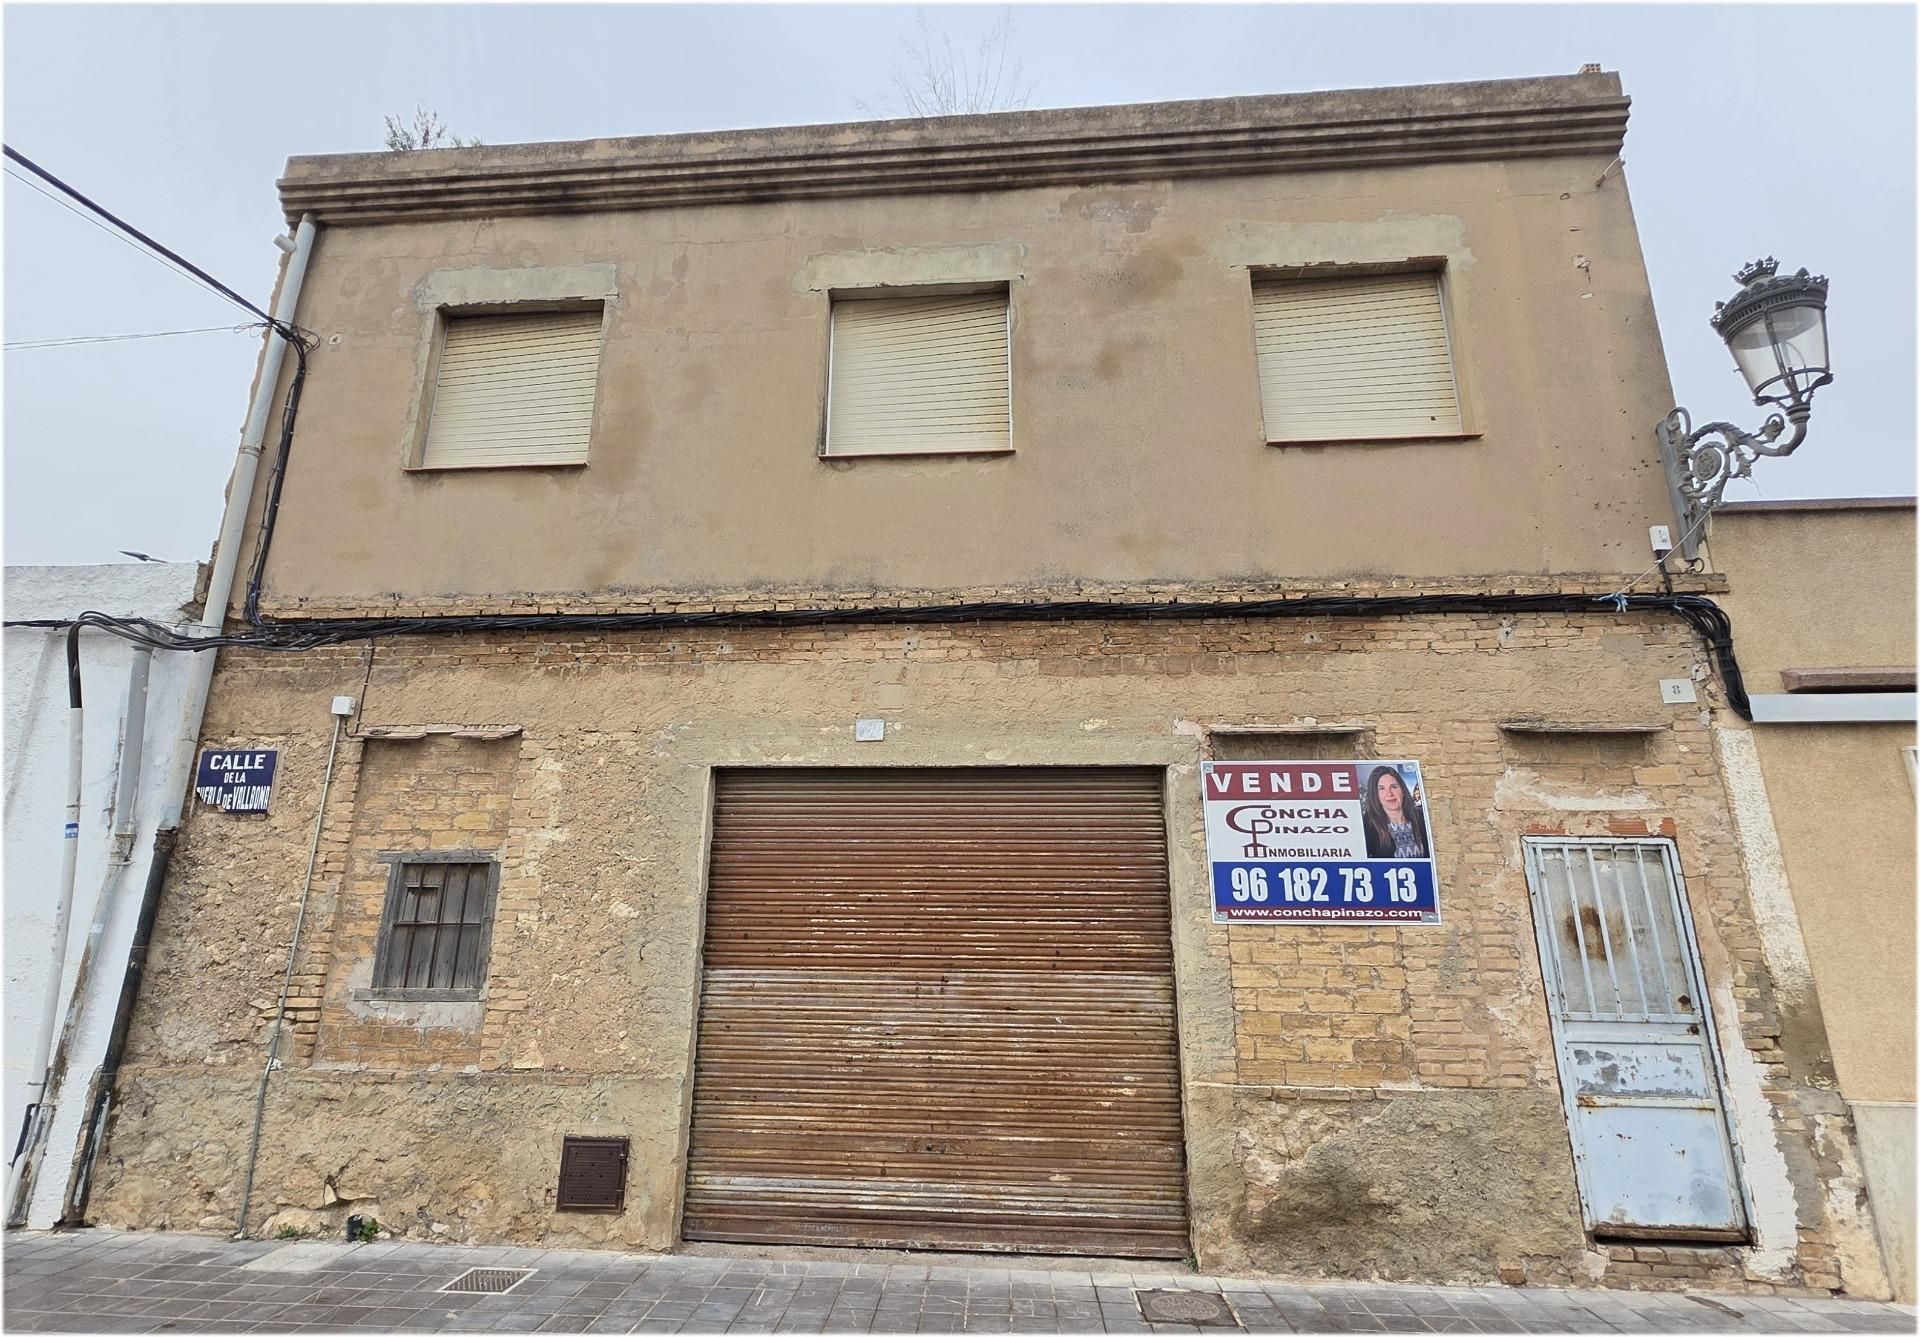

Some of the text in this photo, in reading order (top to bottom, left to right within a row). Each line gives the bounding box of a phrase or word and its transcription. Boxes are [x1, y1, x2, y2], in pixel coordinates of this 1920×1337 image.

[210, 755, 266, 770] CALLE
[223, 772, 246, 784] DE LA
[1211, 772, 1352, 793] VENDE
[222, 794, 232, 809] DE
[1225, 804, 1349, 834] CONCHA
[1250, 819, 1350, 837] PINAZO
[1231, 867, 1418, 902] 96 182 73 13
[1230, 907, 1423, 919] www.conchapinazo.com
